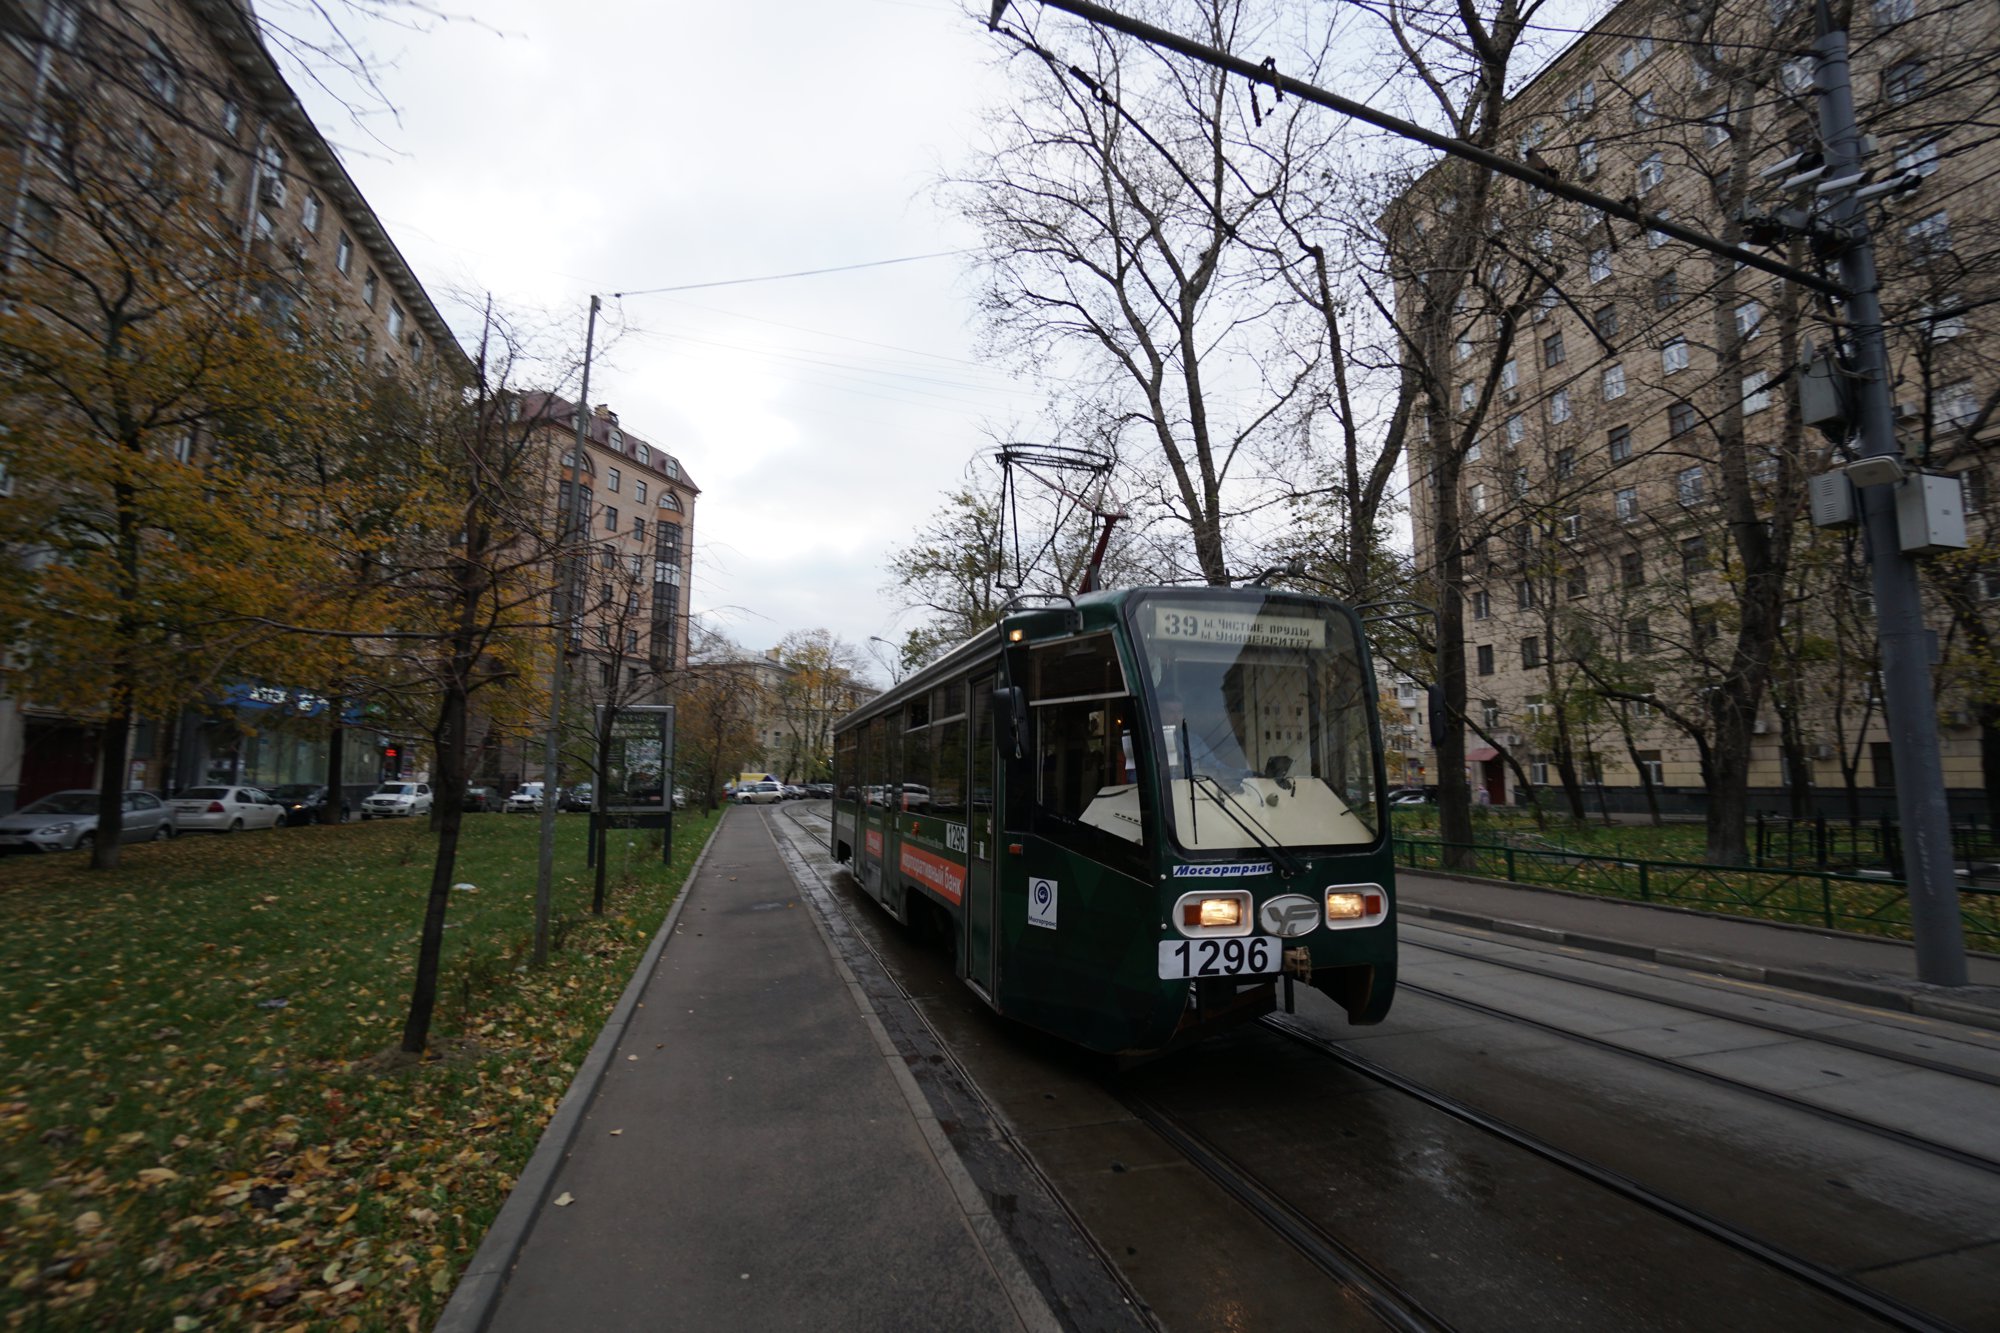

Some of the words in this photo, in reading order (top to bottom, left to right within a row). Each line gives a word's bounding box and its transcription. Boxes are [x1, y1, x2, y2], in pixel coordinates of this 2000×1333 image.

[1164, 613, 1198, 637] 39
[949, 825, 965, 851] 1296
[945, 866, 961, 896] банк
[1174, 864, 1273, 877] Мосгортранс
[1175, 937, 1268, 977] 1296
